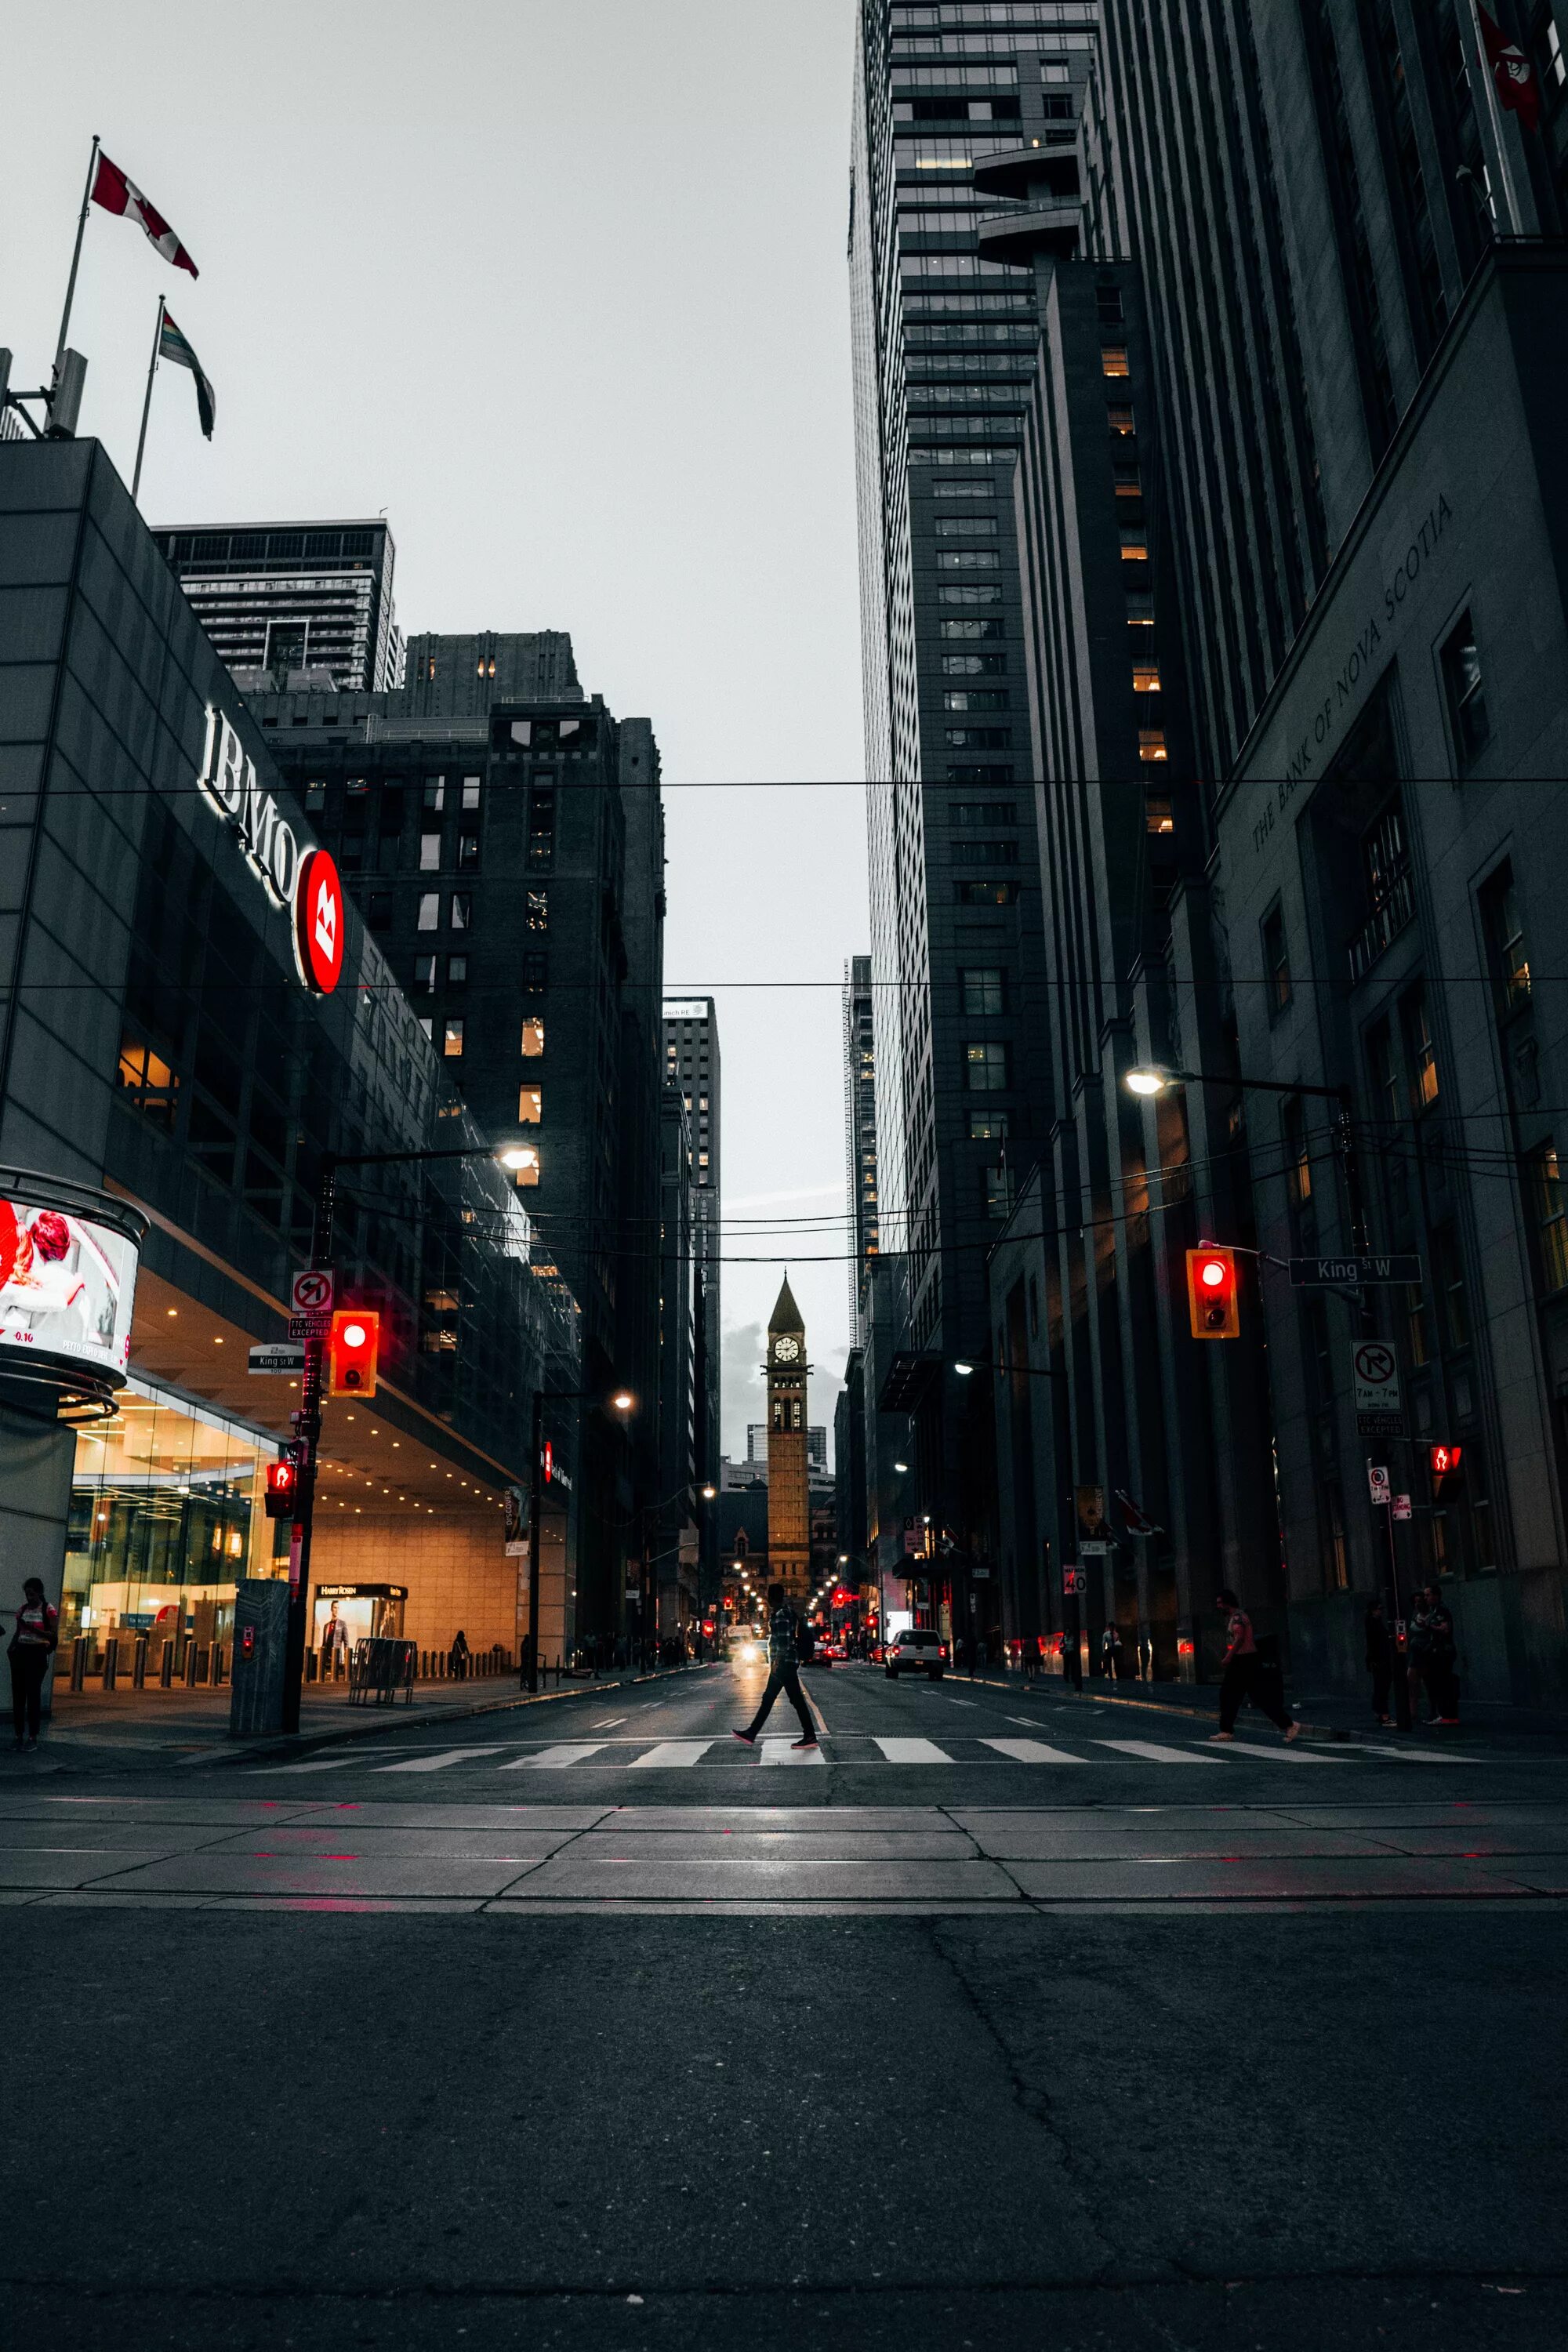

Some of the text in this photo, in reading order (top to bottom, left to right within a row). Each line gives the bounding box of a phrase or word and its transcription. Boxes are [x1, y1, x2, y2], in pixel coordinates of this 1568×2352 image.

[1254, 492, 1453, 854] THE BANK OF NOVA SCOTIA
[200, 704, 299, 904] BMO
[1317, 1258, 1391, 1282] King St W
[291, 1319, 303, 1328] TTC
[260, 1356, 278, 1367] King
[287, 1356, 295, 1365] W
[1360, 1425, 1401, 1434] EXCEPTED
[1065, 1577, 1086, 1591] 40
